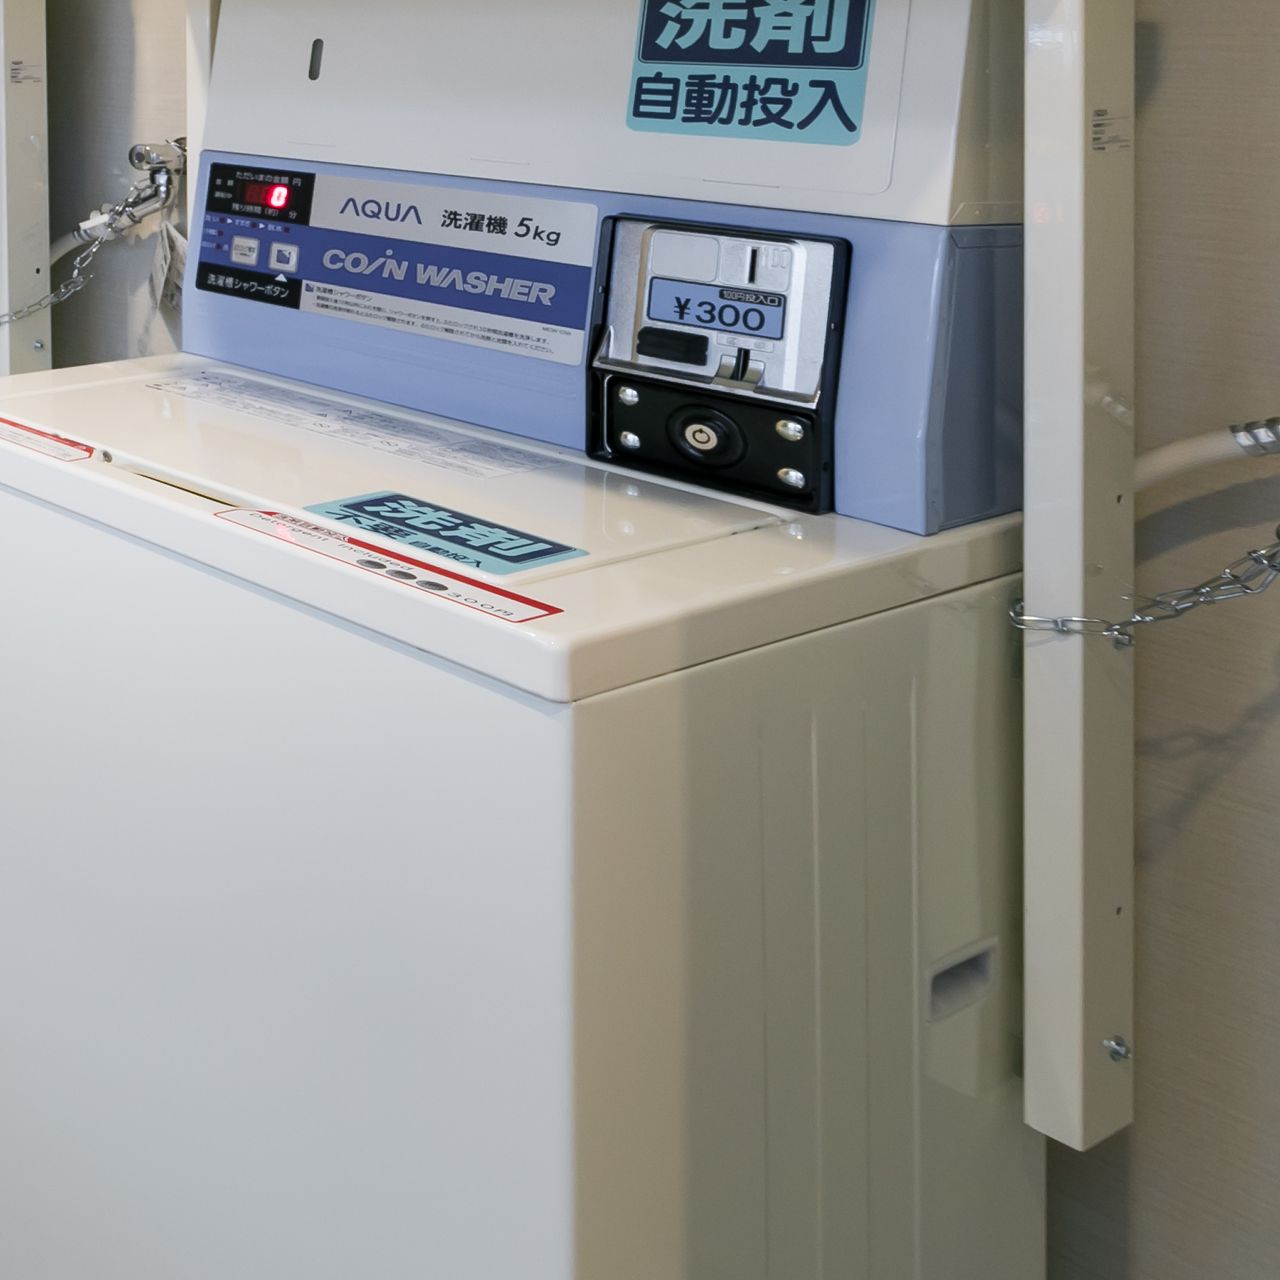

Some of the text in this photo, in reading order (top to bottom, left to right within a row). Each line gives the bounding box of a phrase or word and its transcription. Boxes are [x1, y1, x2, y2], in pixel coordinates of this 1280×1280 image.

[631, 71, 858, 134] 自動投入
[270, 186, 288, 208] 0
[339, 196, 562, 248] AQUA 洗濯機 5kg
[207, 273, 290, 299] 洗濯槽シャワーボタン
[416, 262, 556, 307] WASHER
[674, 296, 766, 331] ¥300
[365, 499, 555, 558] 洗剤
[447, 592, 515, 617] 300円
